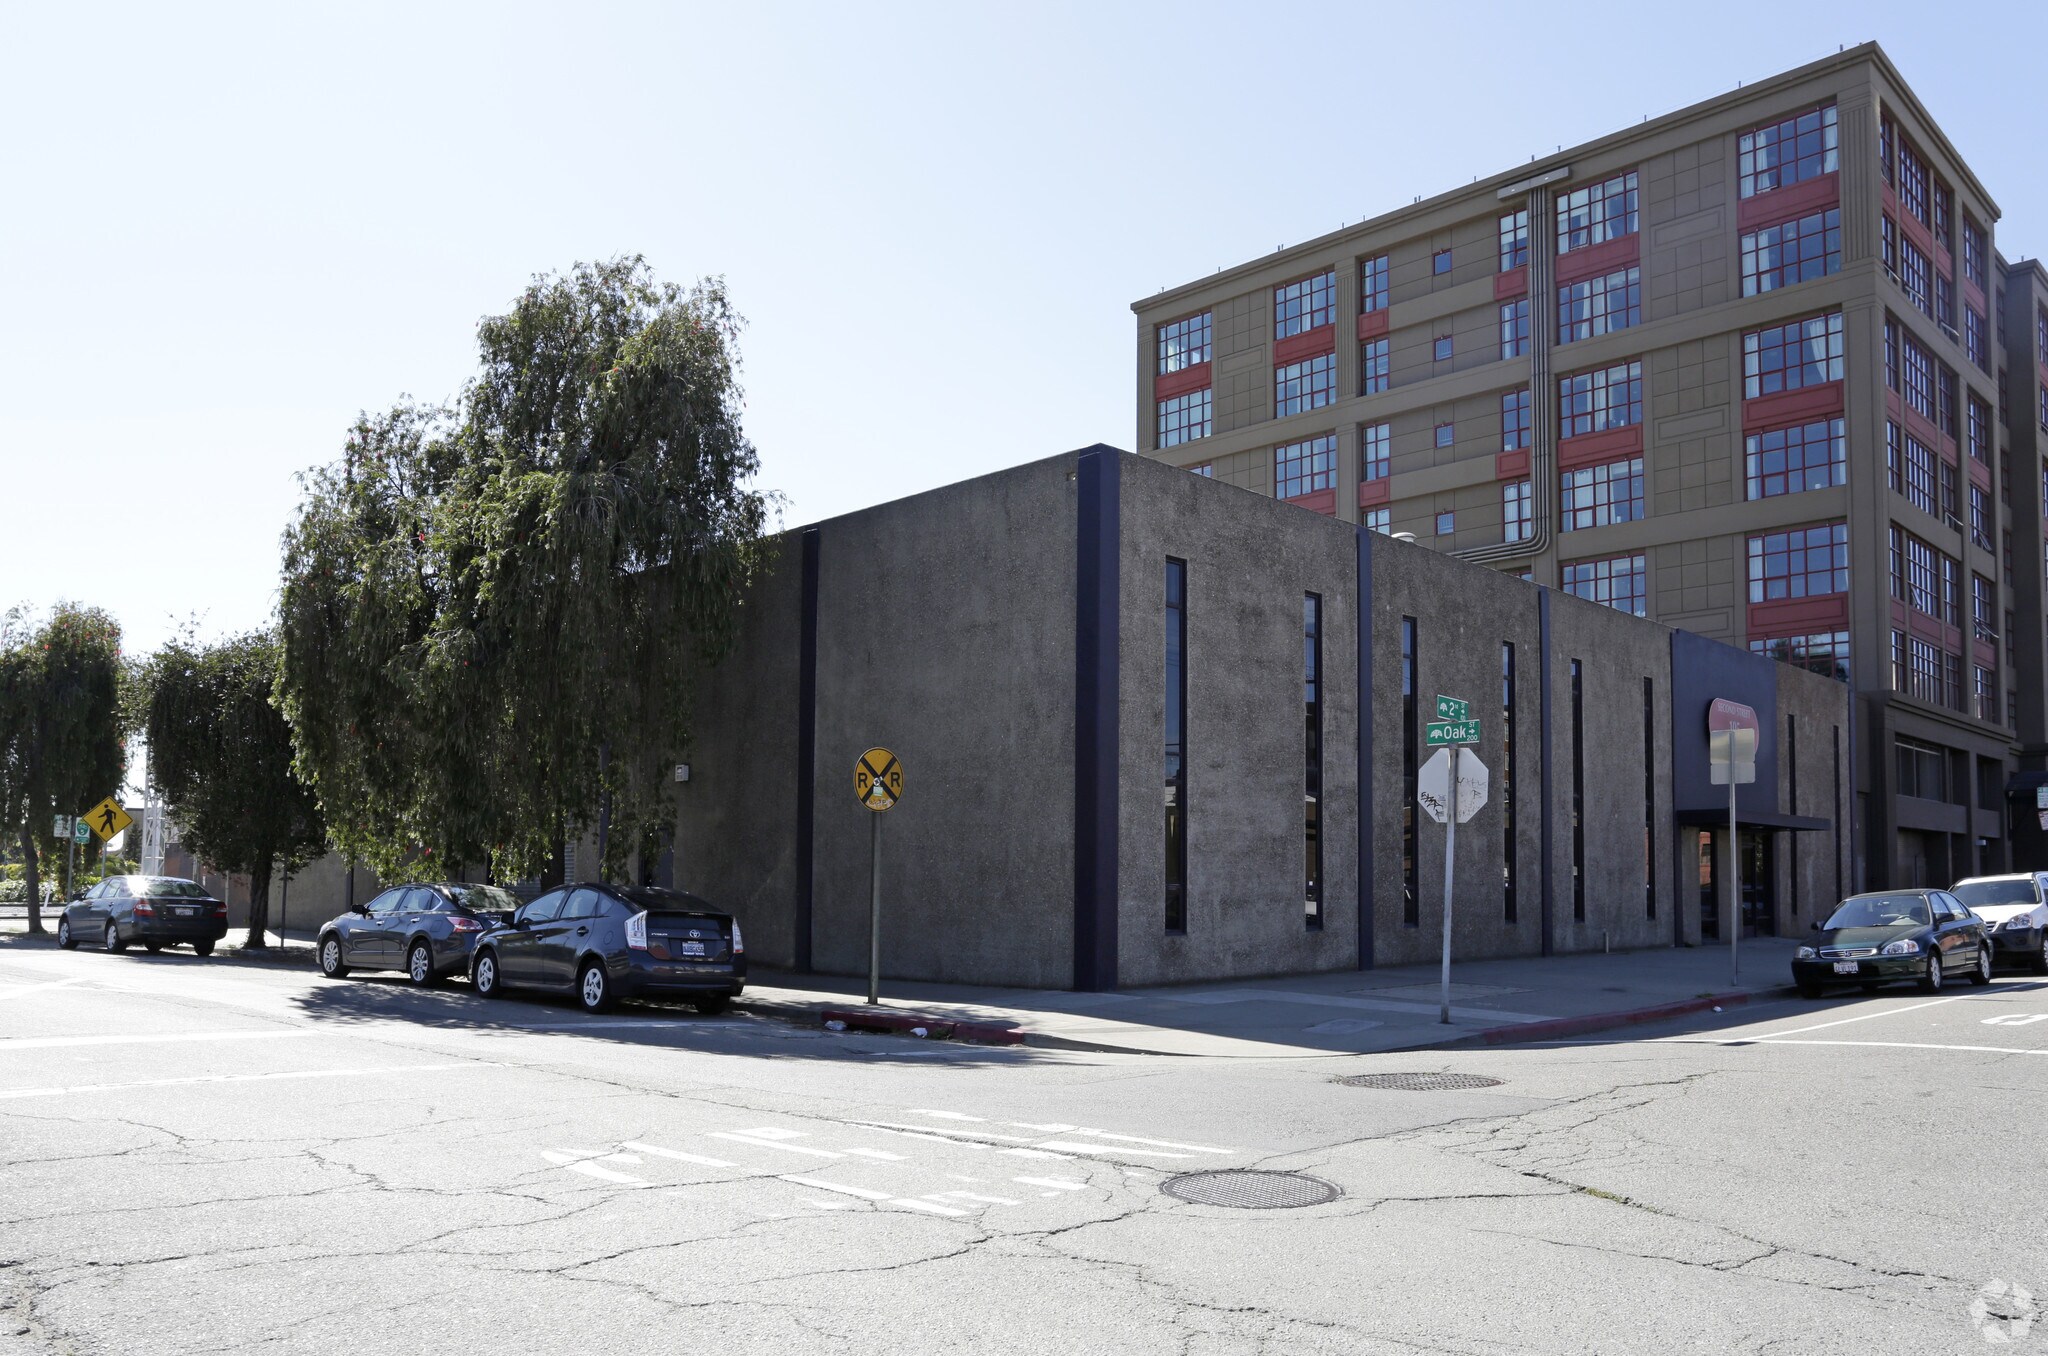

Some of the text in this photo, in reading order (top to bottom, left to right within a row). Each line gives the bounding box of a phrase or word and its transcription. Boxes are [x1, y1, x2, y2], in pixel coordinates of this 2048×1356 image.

[1718, 703, 1751, 719] SECOND STREET
[1444, 725, 1466, 739] Oak
[858, 772, 900, 788] R R
